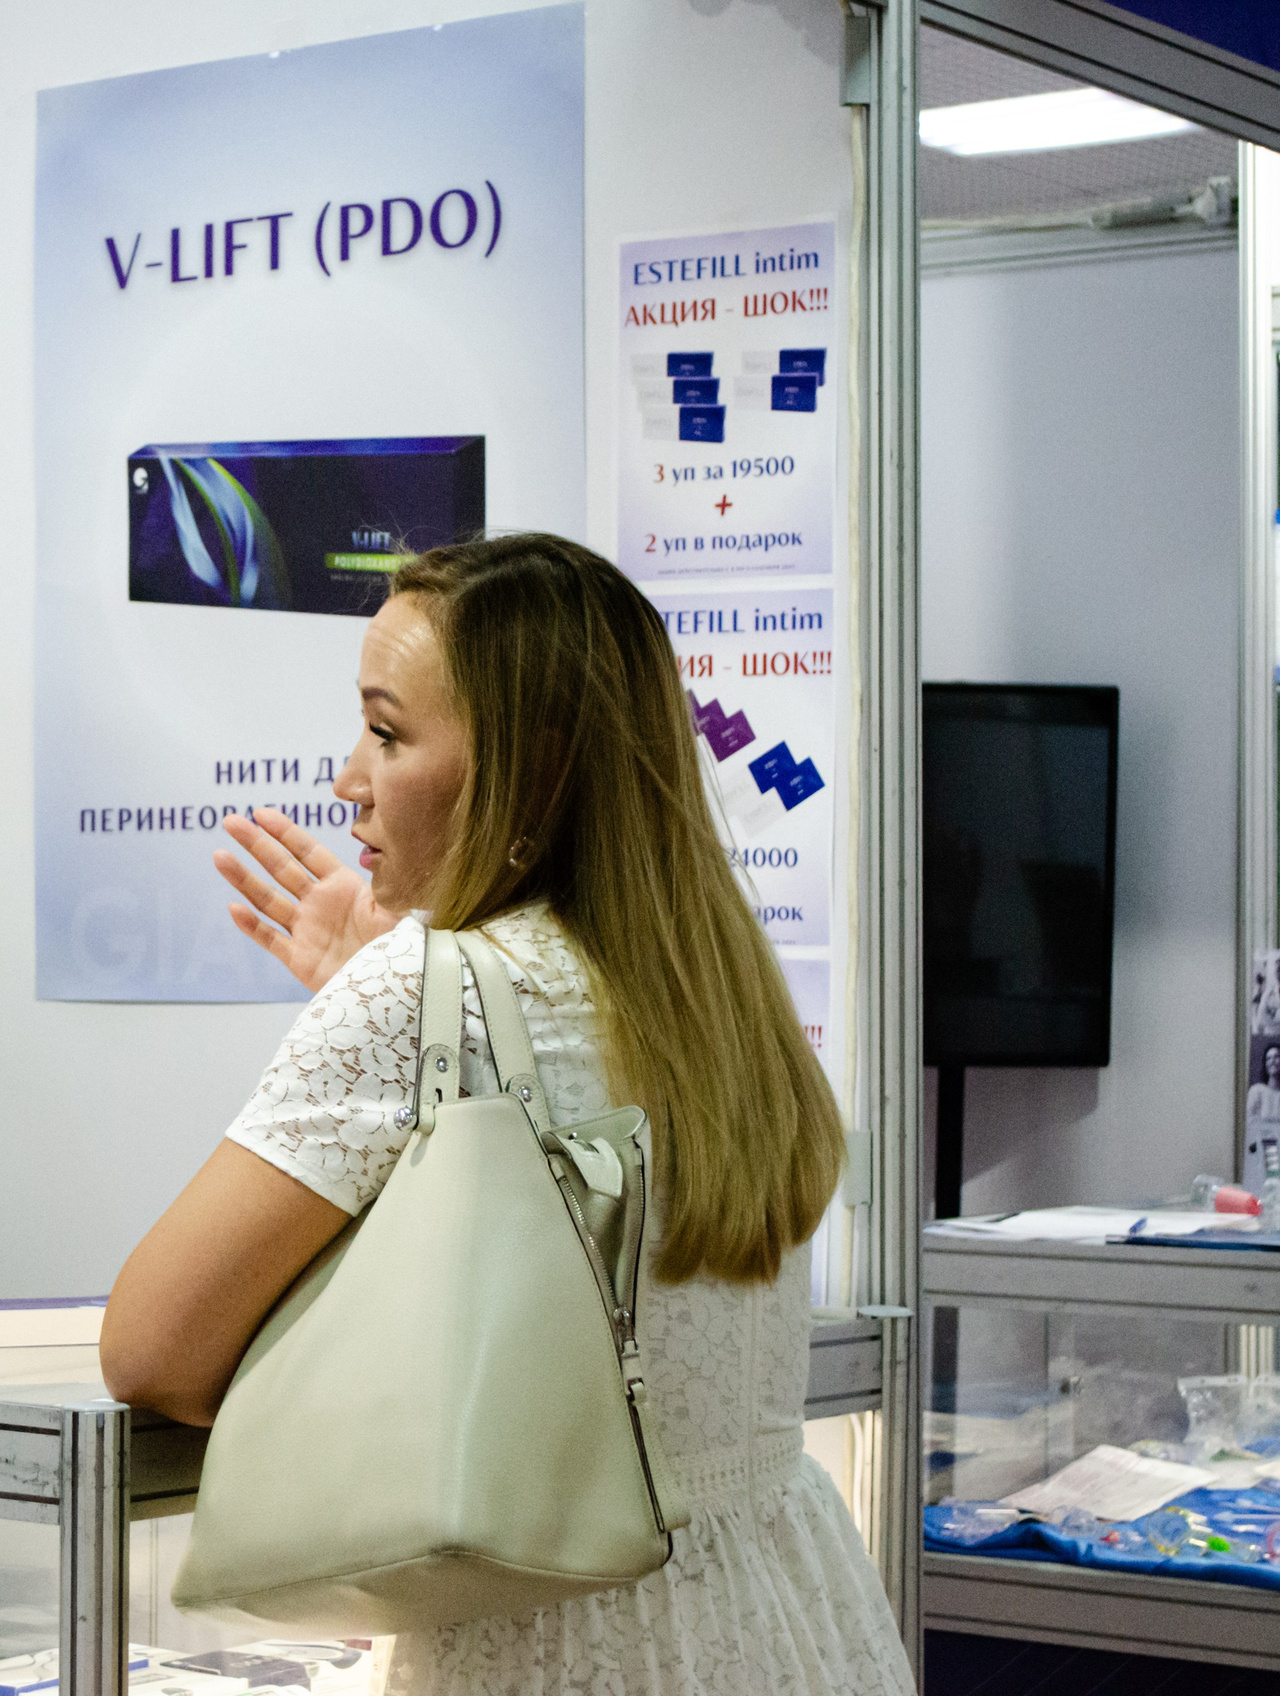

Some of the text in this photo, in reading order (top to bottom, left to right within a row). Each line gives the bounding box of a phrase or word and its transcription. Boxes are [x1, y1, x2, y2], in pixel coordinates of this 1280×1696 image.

[104, 180, 503, 290] V-LIFT (PDO)
[633, 248, 820, 286] ESTEFILL intim
[624, 297, 716, 327] АКЦИЯ
[743, 287, 829, 317] ШОК!!!
[653, 455, 795, 486] 3 уп за 19500
[645, 531, 803, 556] 2 уп в подарок
[754, 606, 824, 632] intim
[741, 650, 833, 676] ШОК!!!
[216, 758, 300, 785] НИТИ
